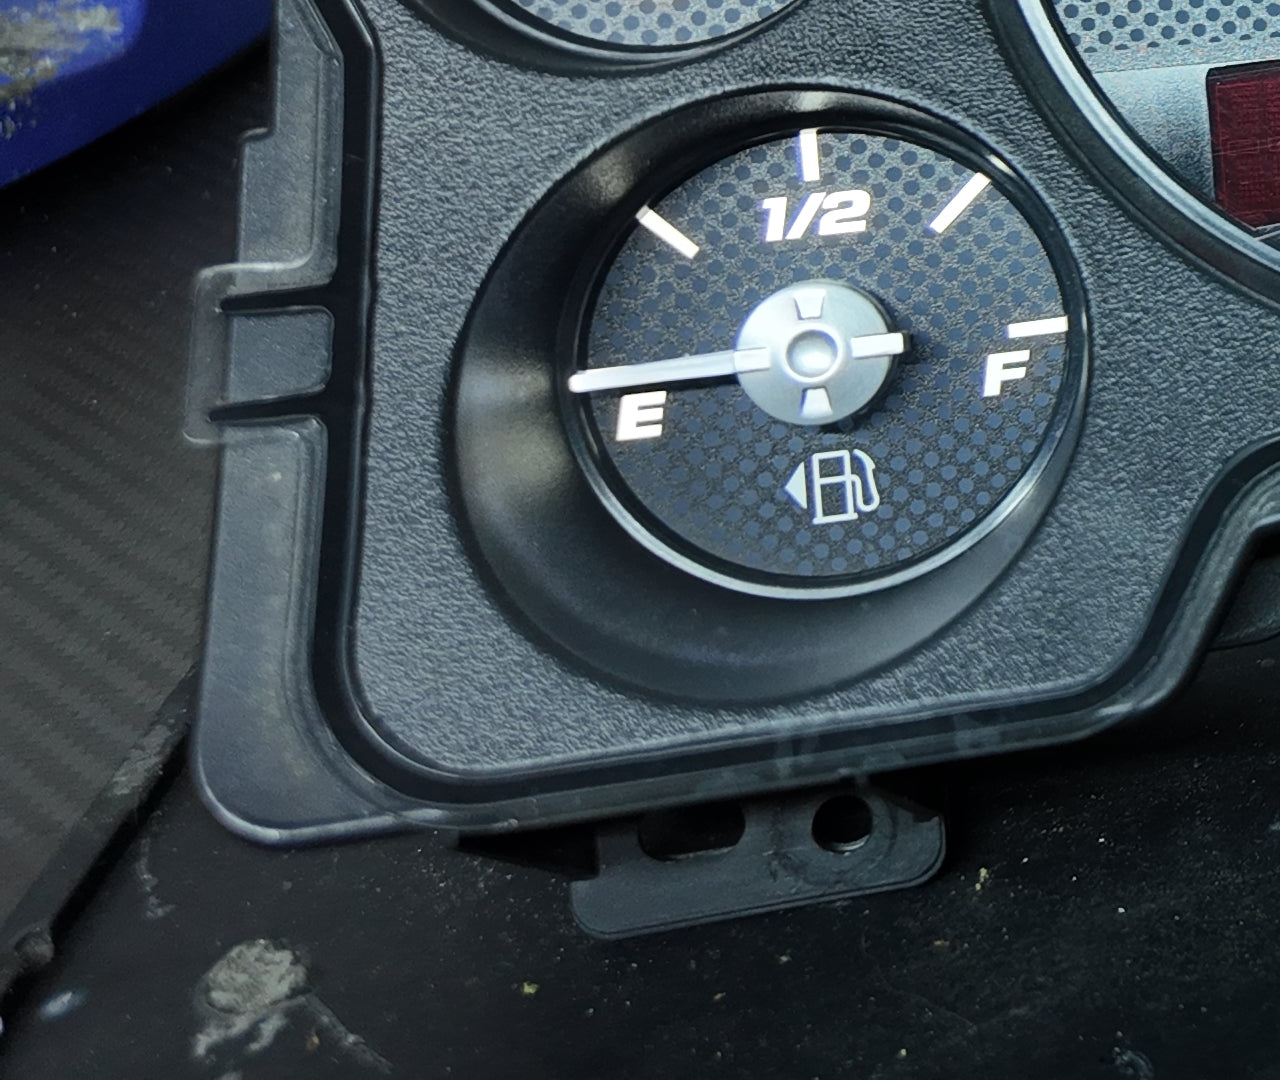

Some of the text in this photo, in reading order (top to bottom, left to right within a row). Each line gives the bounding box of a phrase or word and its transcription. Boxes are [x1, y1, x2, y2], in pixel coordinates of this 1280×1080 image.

[762, 188, 872, 243] 1/2
[981, 348, 1031, 398] F
[615, 390, 667, 442] E
